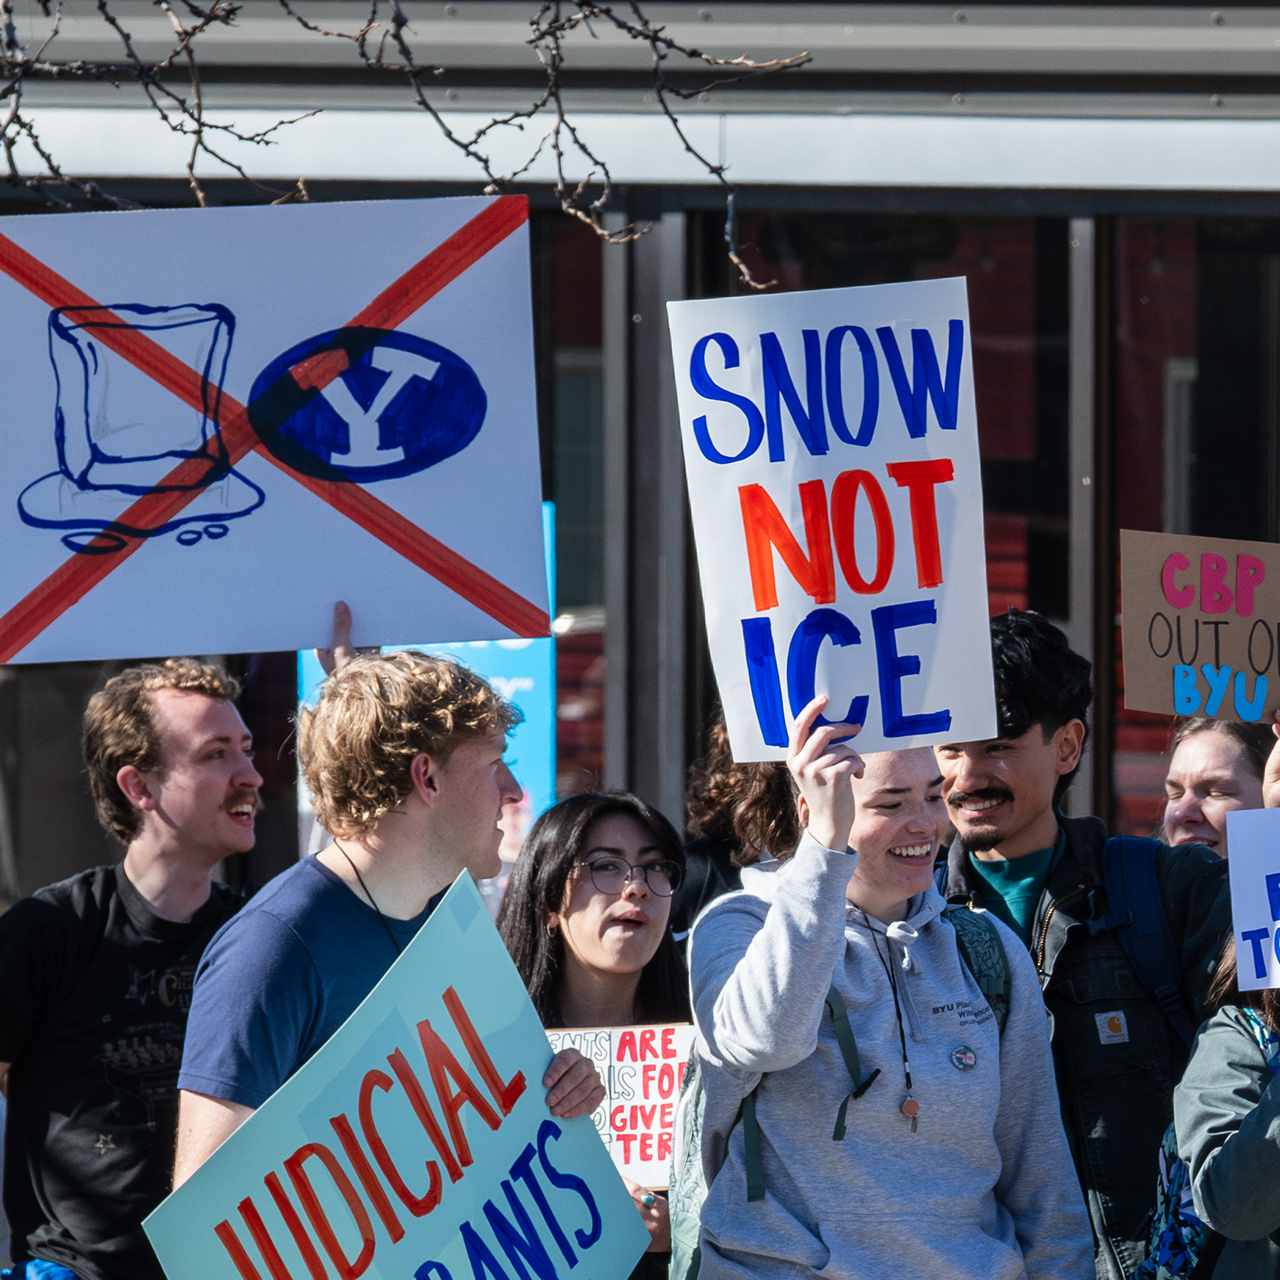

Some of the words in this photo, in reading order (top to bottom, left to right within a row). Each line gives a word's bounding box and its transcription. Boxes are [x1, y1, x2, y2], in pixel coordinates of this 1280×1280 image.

[688, 318, 964, 465] SNOW
[738, 458, 955, 612] NOT
[1160, 551, 1267, 617] CBP
[1148, 611, 1230, 671] OUT
[740, 600, 953, 748] ICE
[1172, 662, 1269, 722] BYU
[932, 1003, 955, 1015] BYU
[615, 1028, 677, 1063] ARE
[610, 1102, 674, 1132] GIVE
